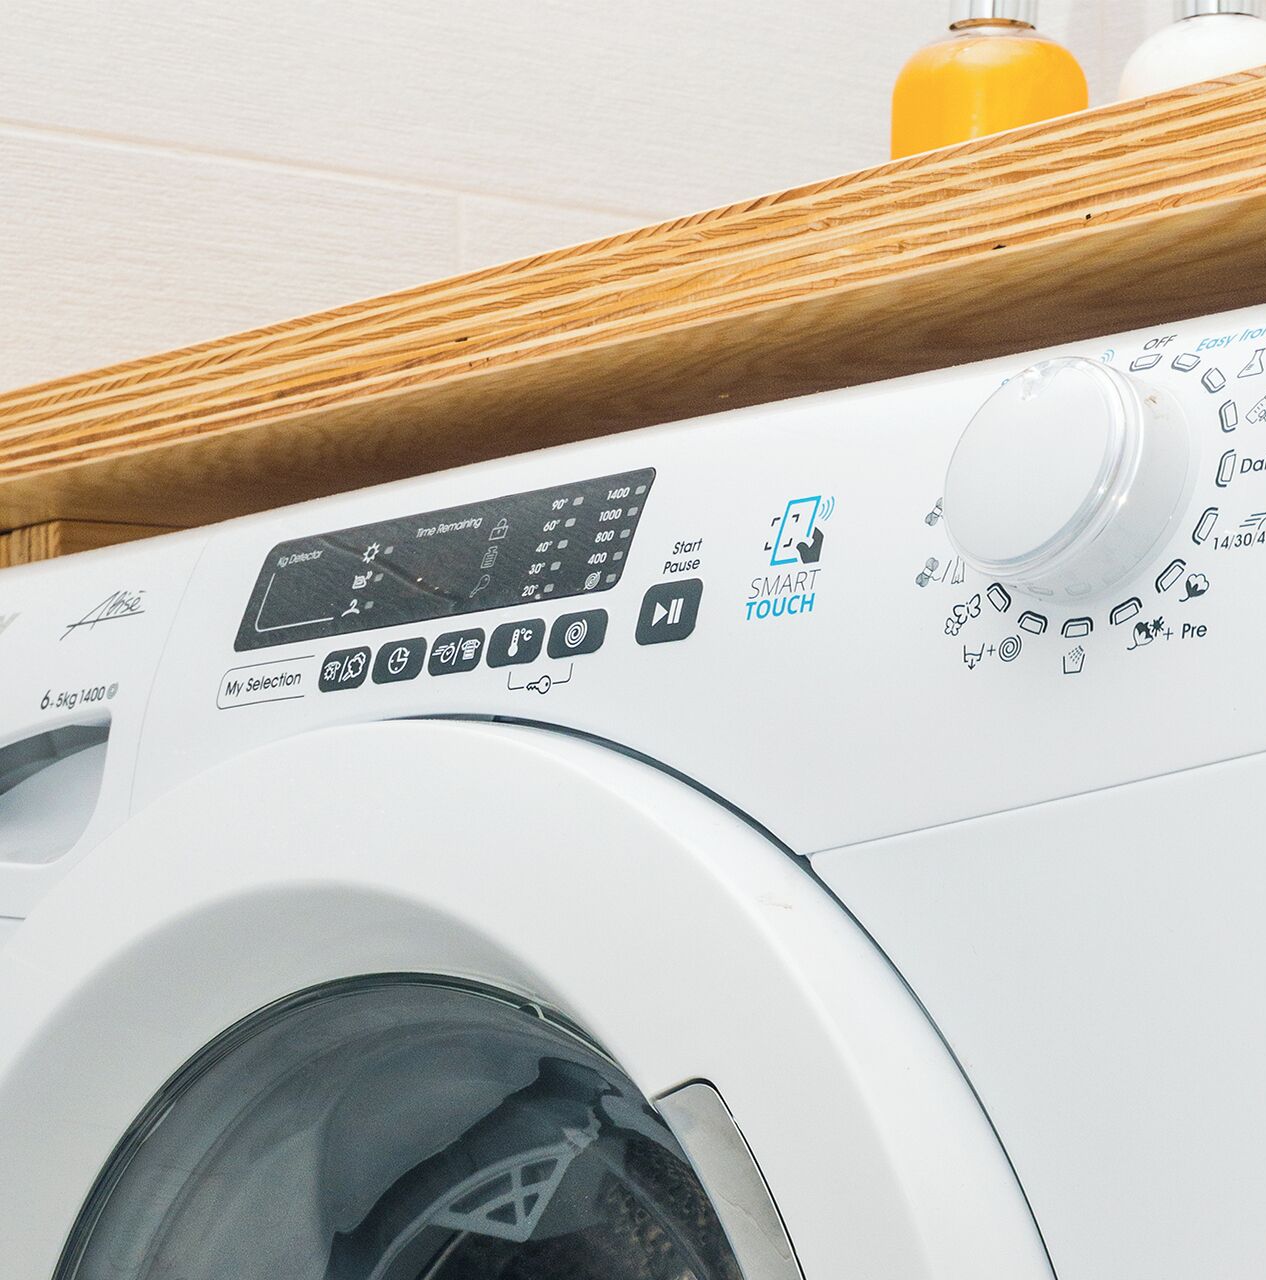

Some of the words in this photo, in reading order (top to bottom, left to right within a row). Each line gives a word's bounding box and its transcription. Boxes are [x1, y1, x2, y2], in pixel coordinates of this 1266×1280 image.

[1143, 334, 1178, 350] OFF
[1195, 335, 1238, 352] Easy
[607, 486, 630, 501] 1400
[551, 498, 569, 511] 90°
[599, 508, 622, 523] 1000
[416, 525, 436, 538] Time
[437, 516, 483, 534] Remaining
[543, 520, 561, 533] 60°
[594, 529, 615, 543] 800
[535, 541, 553, 553] 40°
[672, 538, 703, 555] Start
[289, 550, 323, 566] Detector
[587, 552, 607, 565] 400
[528, 563, 546, 575] 30°
[662, 558, 701, 575] Pause
[521, 584, 539, 597] 20°
[748, 569, 822, 599] SMART
[745, 592, 816, 621] TOUCH
[1181, 623, 1208, 639] Pre
[225, 680, 243, 698] My
[245, 672, 303, 693] Selection
[79, 686, 106, 704] 1400
